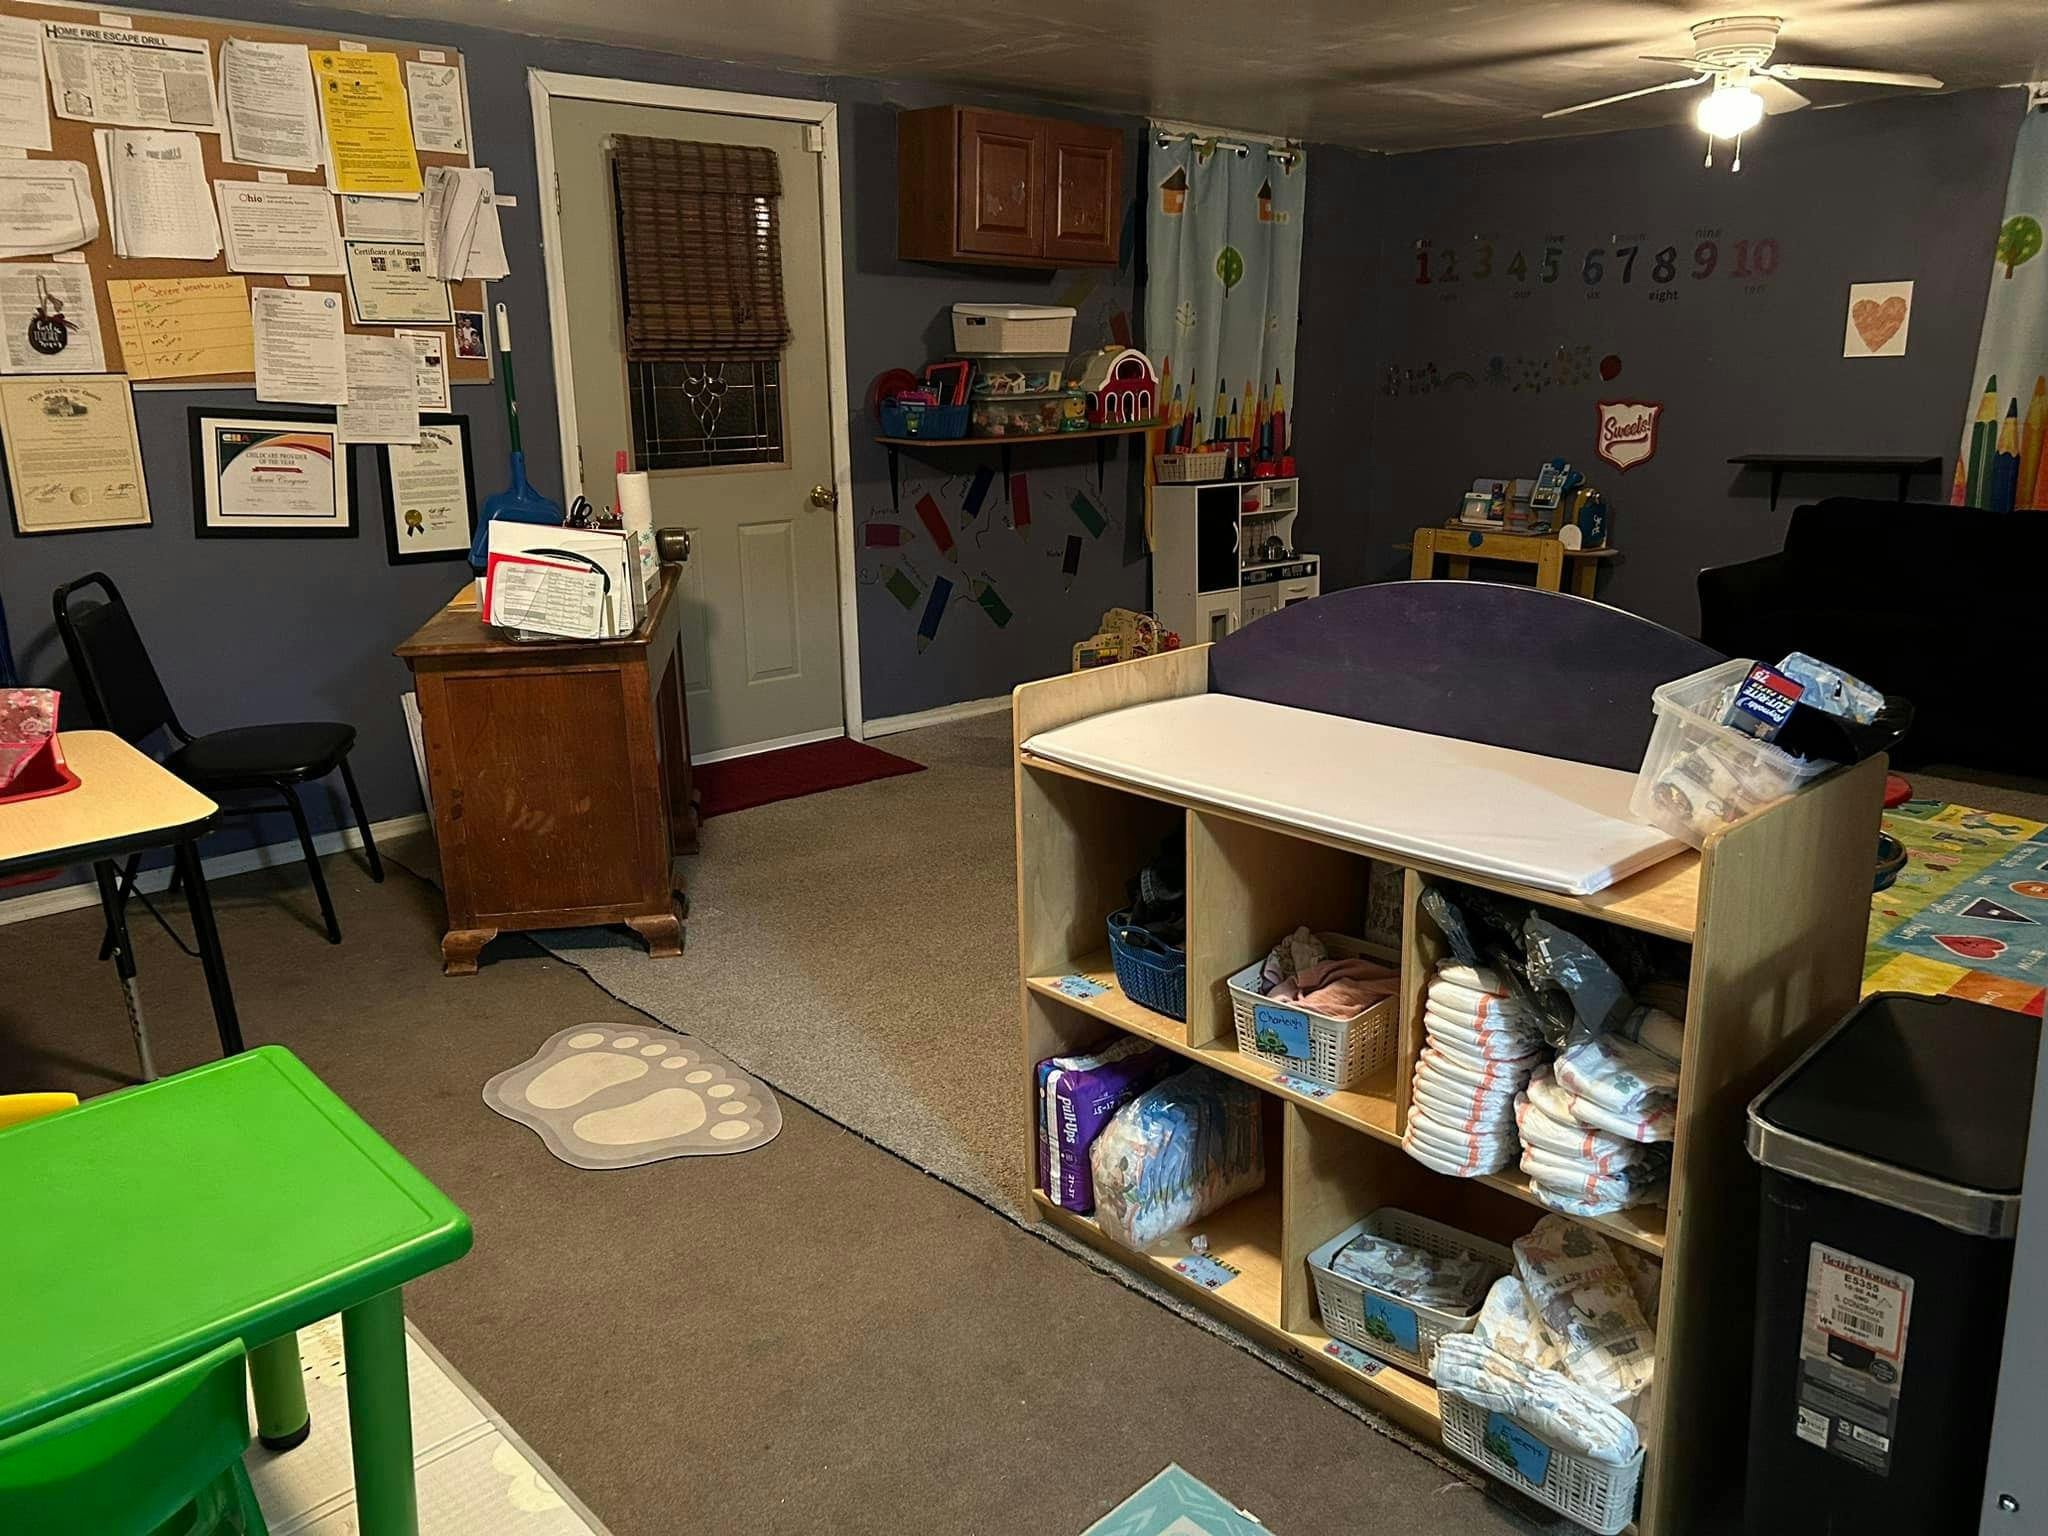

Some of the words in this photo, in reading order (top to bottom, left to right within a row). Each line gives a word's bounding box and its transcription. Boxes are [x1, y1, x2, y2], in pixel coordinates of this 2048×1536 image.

[45, 24, 79, 39] HOME
[80, 28, 101, 40] FIRE
[103, 31, 139, 44] ESCAPE
[141, 35, 168, 46] DRILL
[239, 193, 263, 203] Ohio
[353, 247, 386, 256] Certificate
[387, 248, 396, 256] of
[396, 249, 427, 258] Recognit
[1414, 249, 1432, 285] 1
[1506, 248, 1528, 283] 4
[1542, 248, 1563, 283] 5
[1582, 248, 1605, 286] 6
[1616, 247, 1639, 284] 7
[1652, 246, 1677, 283] 8
[1691, 240, 1718, 280] 9
[1727, 238, 1780, 277] 10
[1648, 288, 1680, 302] eight
[1603, 412, 1653, 442] Sweets!
[1742, 686, 1792, 714] CUT-RITE
[1748, 700, 1785, 722] Reynolds
[1844, 1274, 1880, 1293] E5355
[1858, 1265, 1900, 1289] Homes
